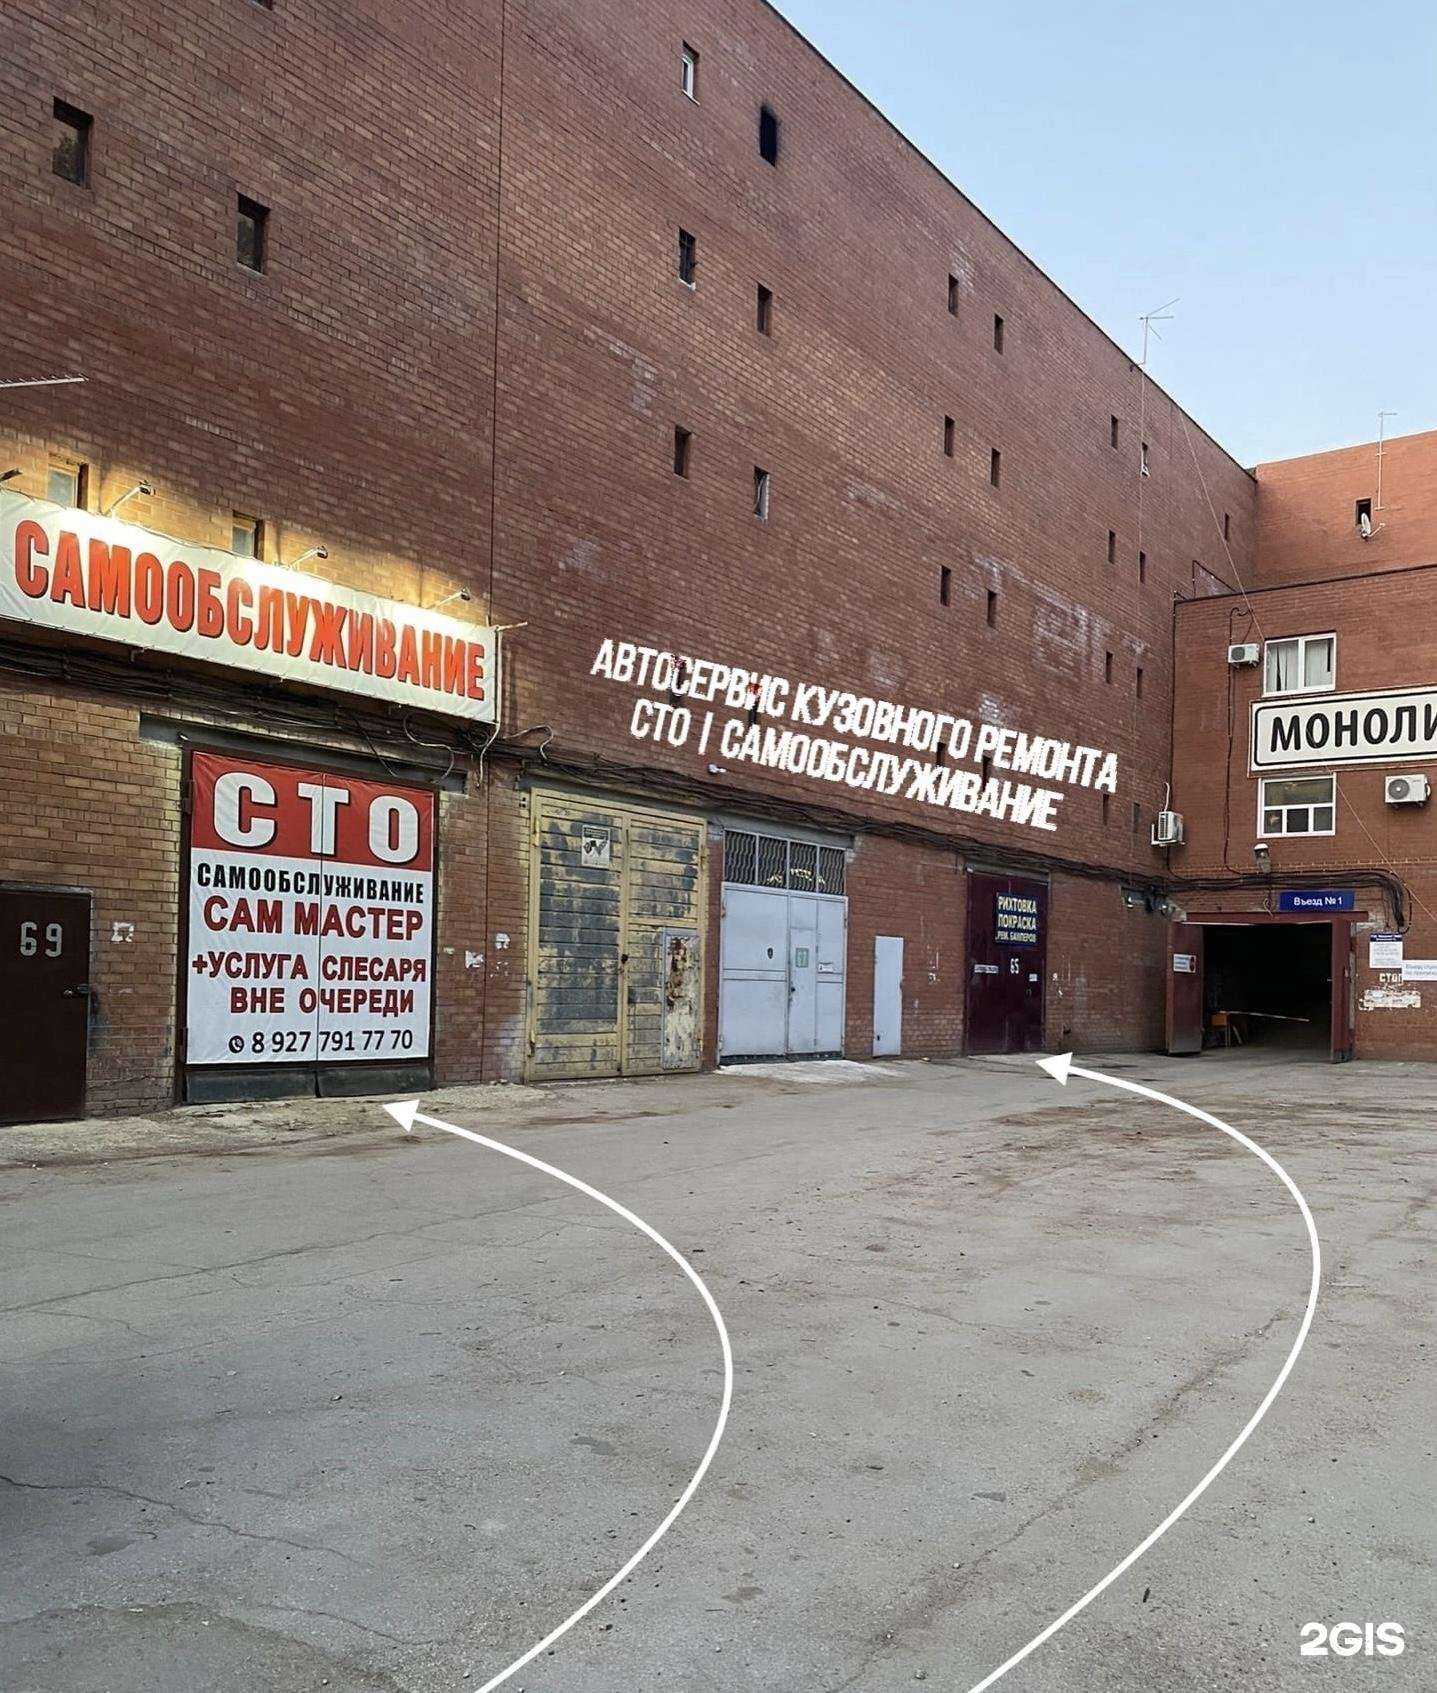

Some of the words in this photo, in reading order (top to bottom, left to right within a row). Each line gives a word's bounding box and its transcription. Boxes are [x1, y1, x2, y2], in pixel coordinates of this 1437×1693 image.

[14, 519, 486, 701] САМООБСЛУЖИВАНИЕ
[213, 771, 420, 864] СТО
[197, 862, 424, 904] САМООБСЛУЖИВАНИЕ
[998, 895, 1037, 914] РИХТОВКА
[1293, 896, 1322, 906] Въезд
[203, 895, 283, 934] САМ
[294, 901, 423, 941] МАСТЕР
[19, 921, 63, 958] 69
[192, 951, 309, 980] +УСЛУГА
[322, 954, 427, 983] СЛЕСАРЯ
[1010, 958, 1020, 974] 65
[230, 987, 285, 1014] ВНЕ
[299, 988, 414, 1018] ОЧЕРЕДИ
[251, 1033, 265, 1053] 8
[271, 1031, 312, 1052] 927
[317, 1031, 356, 1052] 791
[361, 1030, 384, 1050] 77
[390, 1029, 413, 1050] 70
